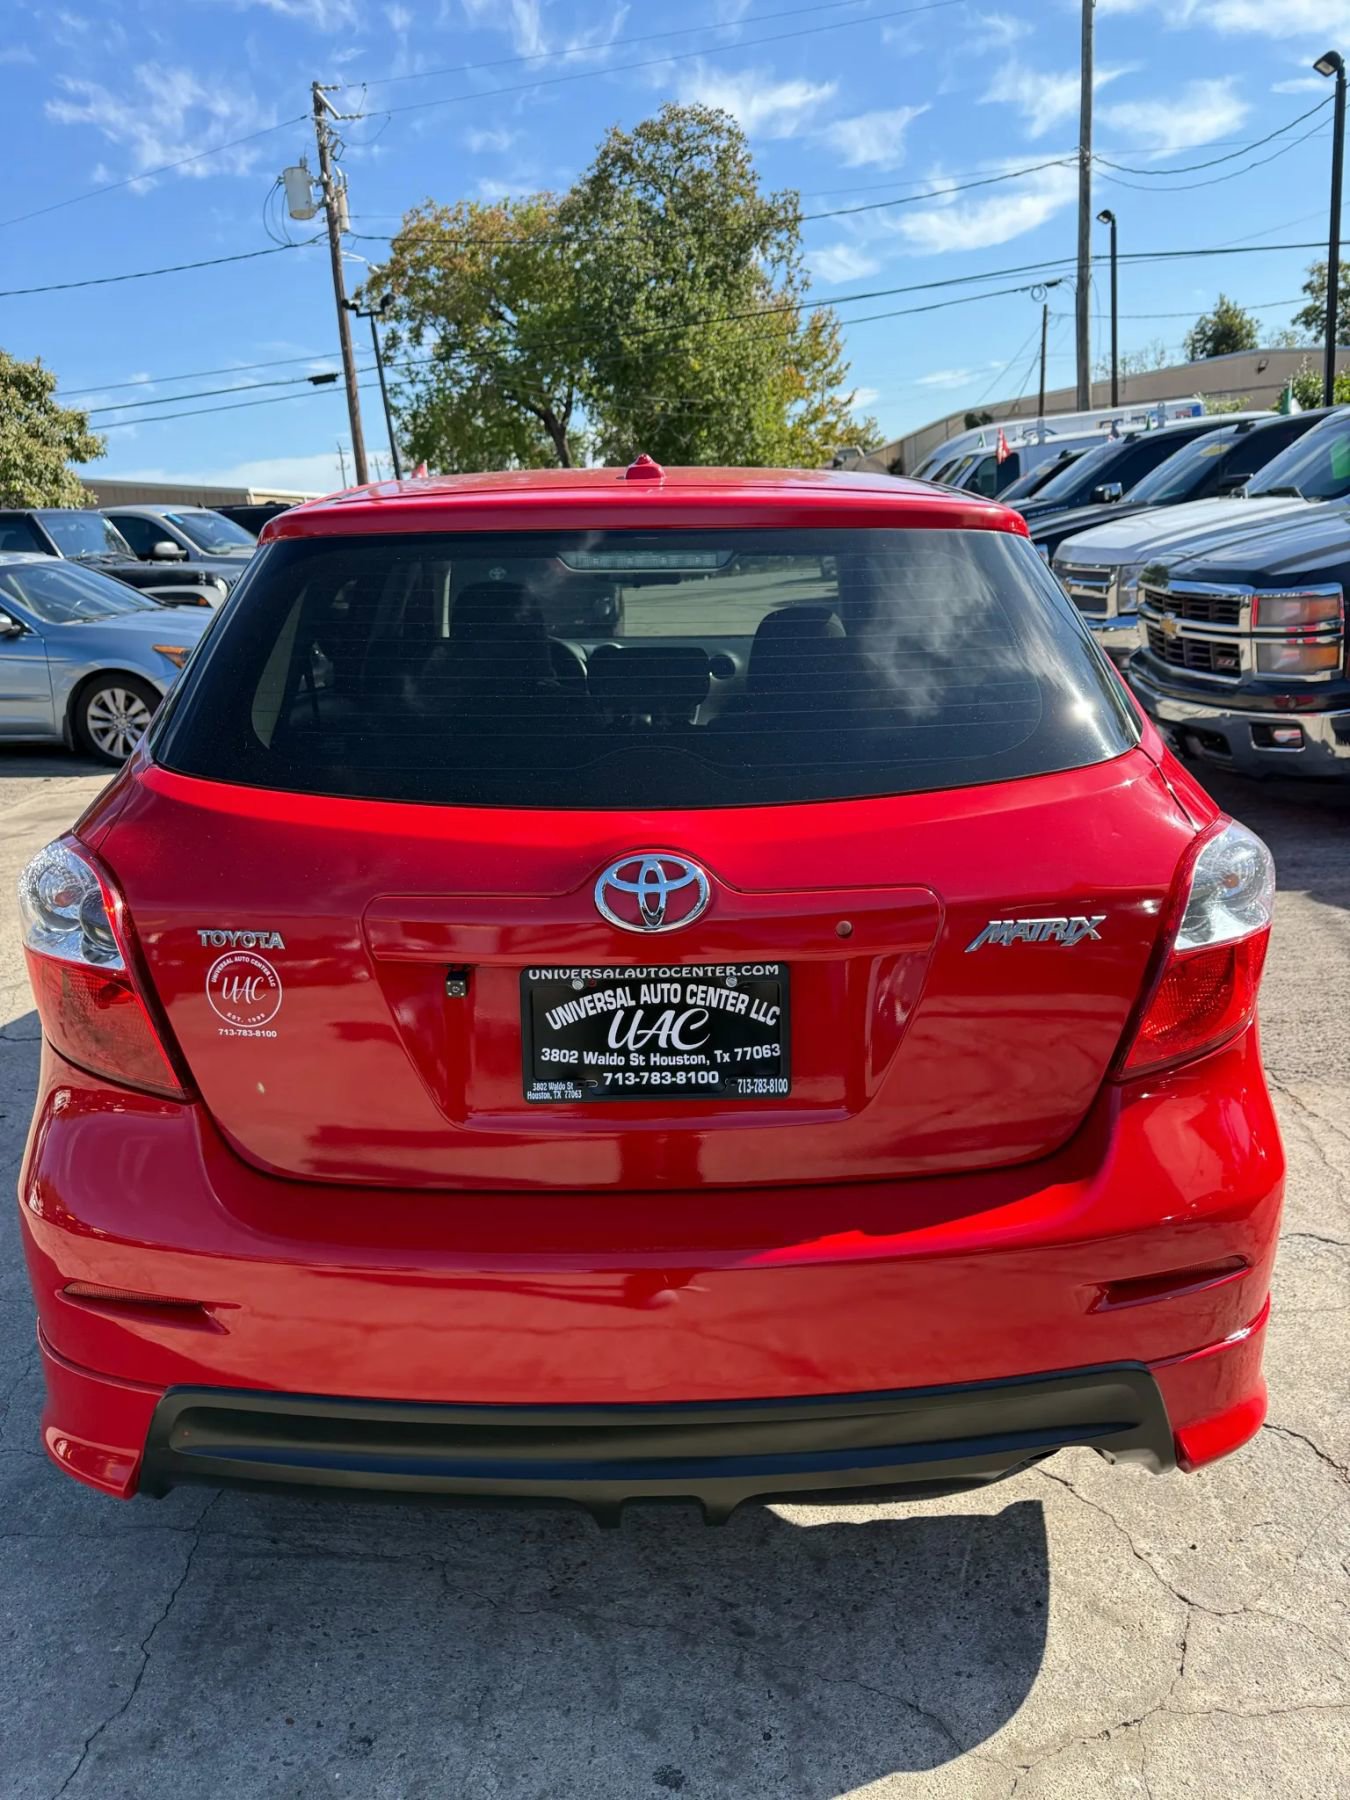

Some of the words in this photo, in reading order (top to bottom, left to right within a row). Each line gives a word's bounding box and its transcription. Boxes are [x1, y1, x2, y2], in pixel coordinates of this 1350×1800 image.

[197, 929, 286, 950] TOYOTA
[964, 915, 1107, 953] MATRIX
[211, 957, 234, 983] UNIVERSAL
[250, 958, 271, 976] CENTER
[528, 965, 779, 980] UNIVERSALAUTOCENTER.COM
[223, 976, 266, 1004] UAC
[545, 987, 636, 1030] UNIVERSAL
[639, 983, 681, 1005] AUTO
[686, 984, 750, 1015] CENTER
[749, 998, 781, 1026] LLC
[218, 1028, 277, 1038] 713-783-8100
[607, 1008, 711, 1051] UAC
[541, 1047, 578, 1064] 3802
[583, 1051, 625, 1066] Waldo
[629, 1052, 646, 1066] St
[650, 1052, 710, 1066] Houston,
[714, 1049, 731, 1063] Tx
[734, 1043, 781, 1061] 77063
[533, 1082, 548, 1091] 3802
[548, 1081, 565, 1091] Waldo
[566, 1082, 574, 1090] St
[603, 1070, 719, 1086] 713-783-8100
[737, 1078, 788, 1094] 713-783-8100
[553, 1090, 562, 1099] TX
[564, 1090, 582, 1099] 77063
